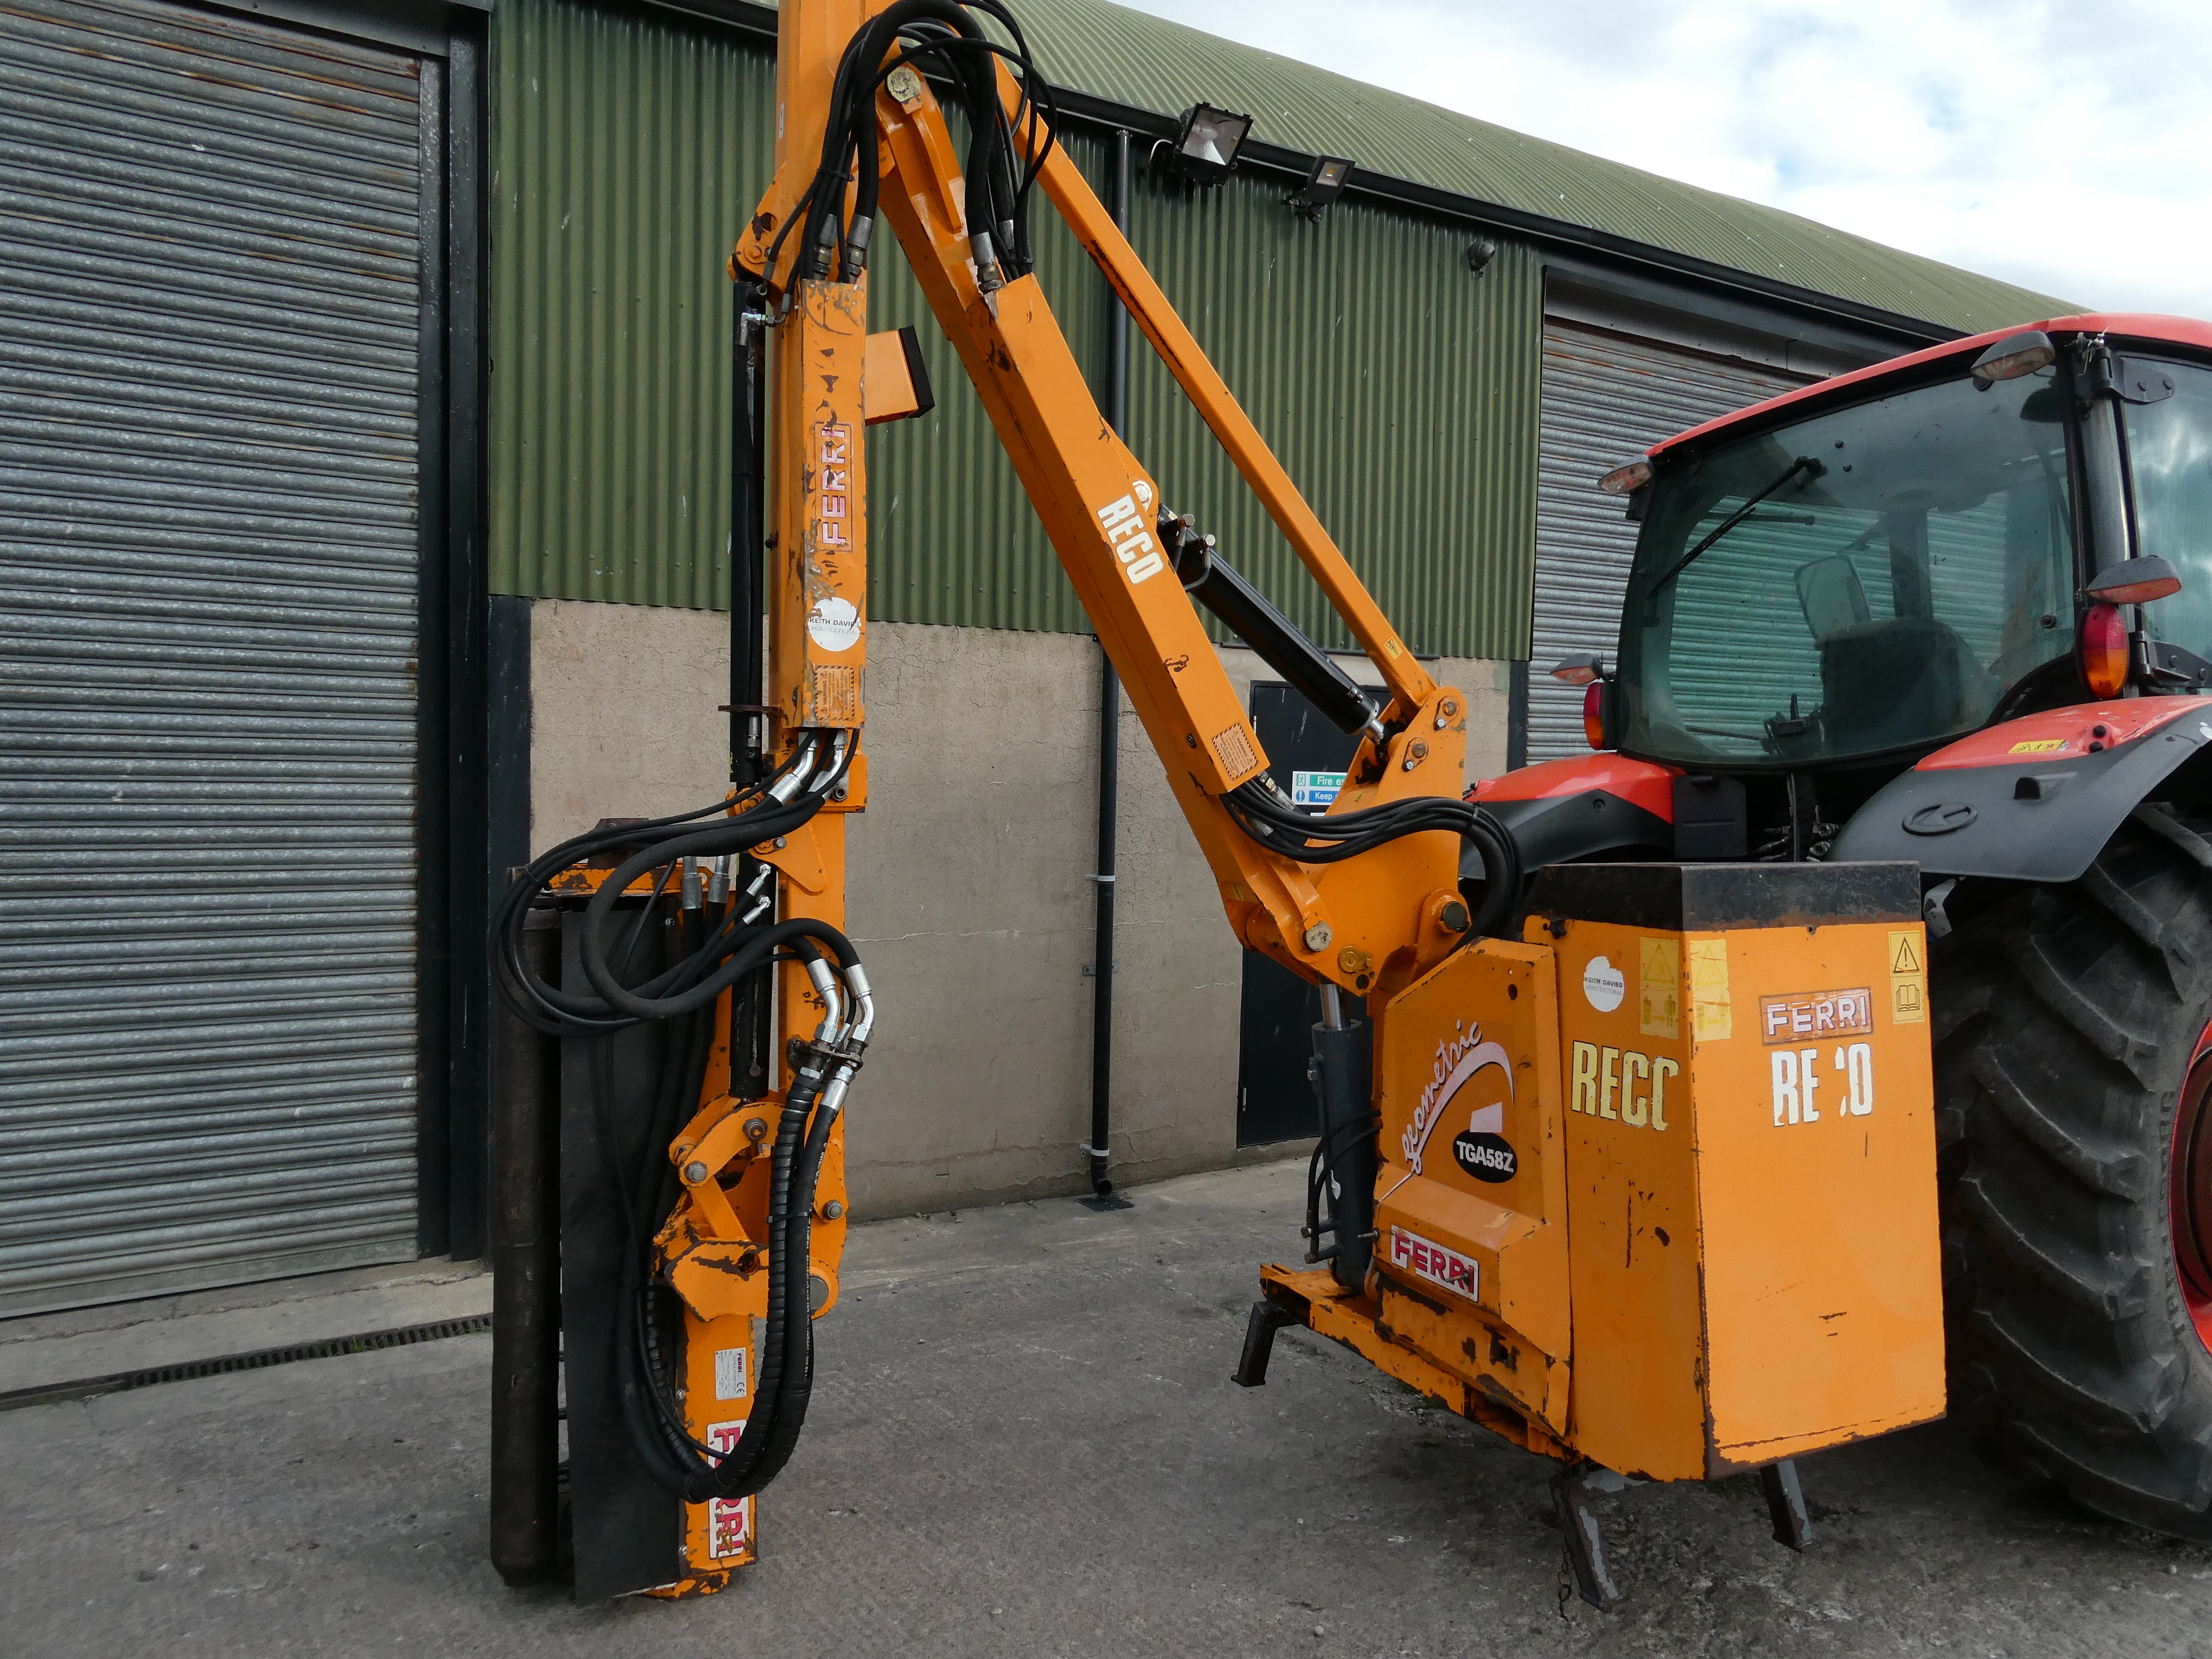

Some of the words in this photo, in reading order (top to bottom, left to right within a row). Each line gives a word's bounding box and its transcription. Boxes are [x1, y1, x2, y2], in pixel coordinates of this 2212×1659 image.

[821, 428, 846, 544] FERRI
[1097, 494, 1164, 584] RECO
[1237, 737, 1248, 758] WARNING
[1315, 792, 1333, 801] Keep
[1318, 776, 1333, 786] Fire
[1585, 985, 1623, 995] AGRICULTURAL
[1603, 980, 1623, 988] DAVIES
[1766, 995, 1868, 1036] FERRI
[1771, 1042, 1873, 1127] REO
[1456, 1140, 1514, 1173] TGA58Z
[1394, 1233, 1475, 1295] FERRI
[714, 1427, 742, 1551] FRI
